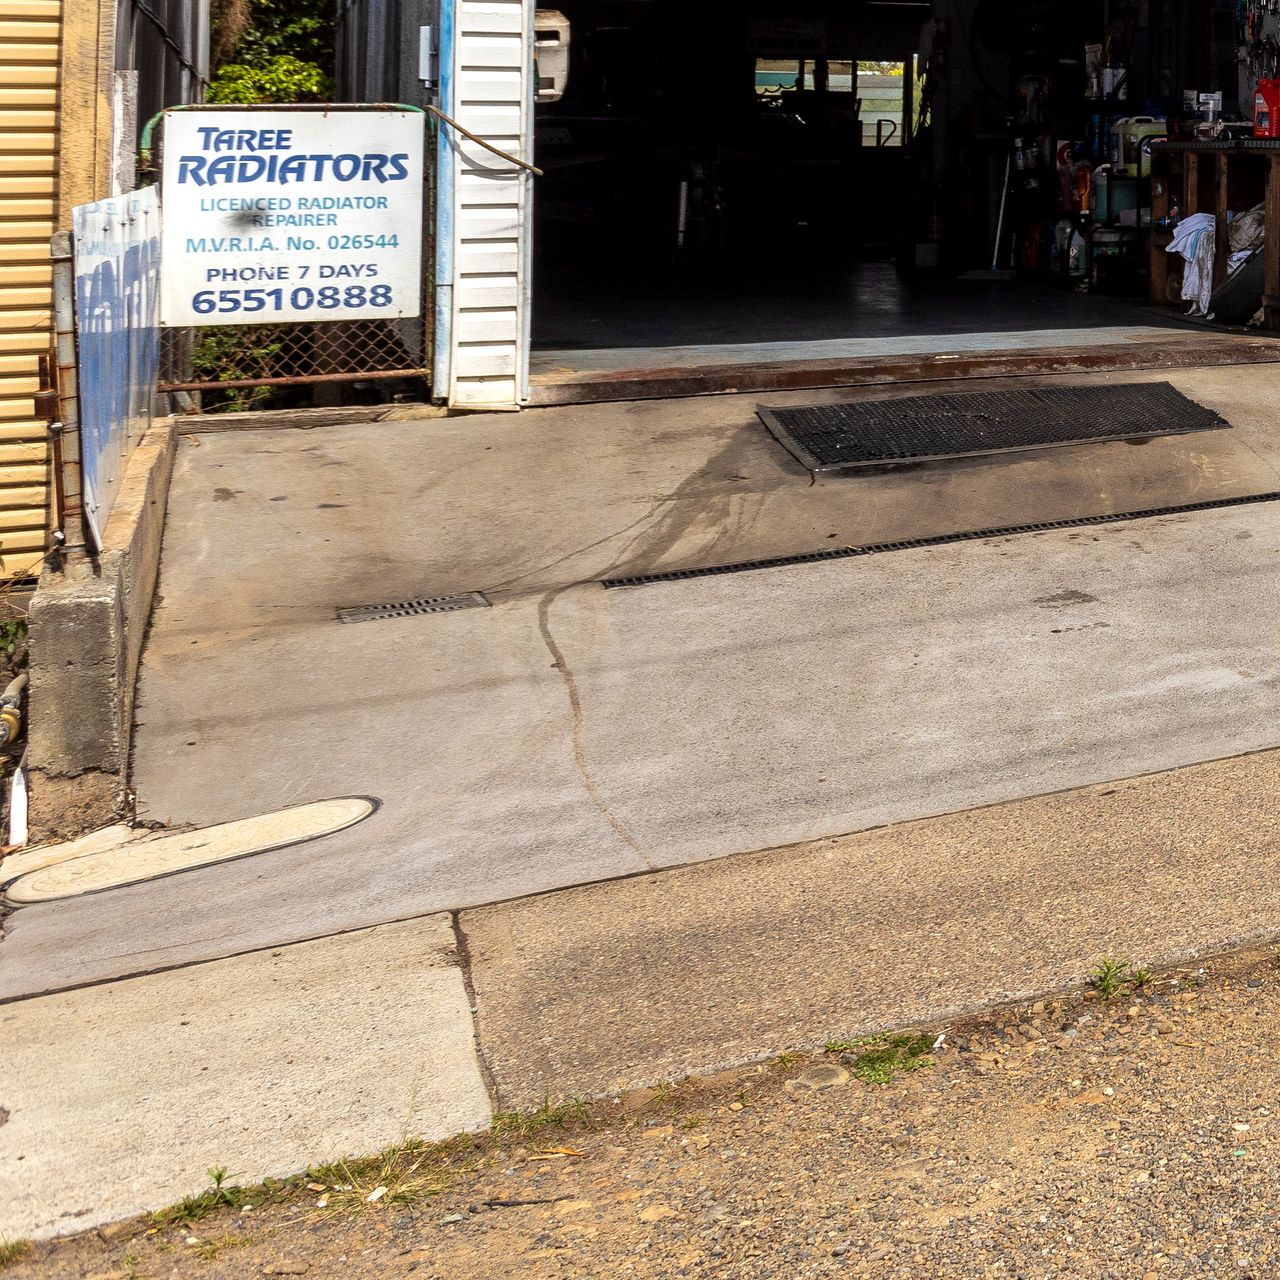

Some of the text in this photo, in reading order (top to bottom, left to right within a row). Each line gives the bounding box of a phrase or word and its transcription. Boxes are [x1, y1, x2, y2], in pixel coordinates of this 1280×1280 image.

[197, 127, 293, 152] TAREE
[178, 153, 409, 187] RADIATORS
[201, 196, 388, 211] LICENCED RADIATOR
[252, 213, 337, 228] REPAIRER
[186, 234, 399, 253] M.V.R.I.A. No. 026544
[206, 263, 378, 282] PHONE 7 DAYS
